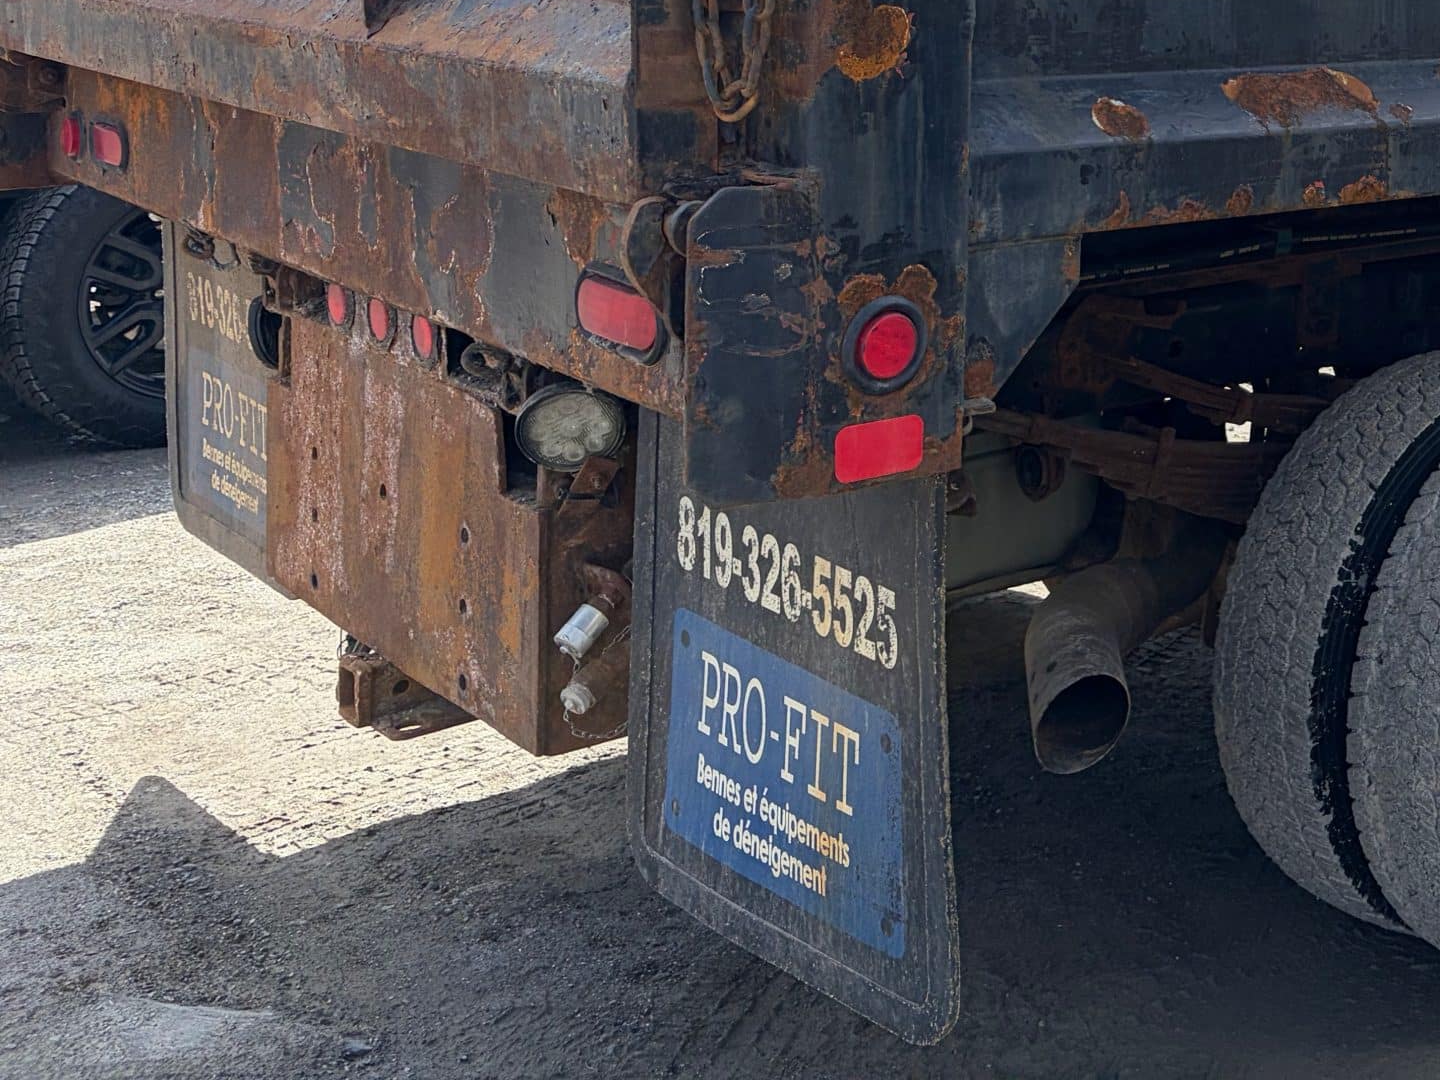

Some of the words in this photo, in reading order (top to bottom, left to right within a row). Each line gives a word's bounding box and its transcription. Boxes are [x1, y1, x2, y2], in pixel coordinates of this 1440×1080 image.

[201, 371, 267, 462] PRO-FIT
[677, 495, 898, 670] 819-326-5525
[697, 650, 860, 816] PRO-FIT
[697, 752, 741, 806] Bennes
[743, 784, 758, 815] et
[759, 787, 850, 868] équipements
[713, 807, 731, 841] de
[733, 818, 827, 897] déneigement
